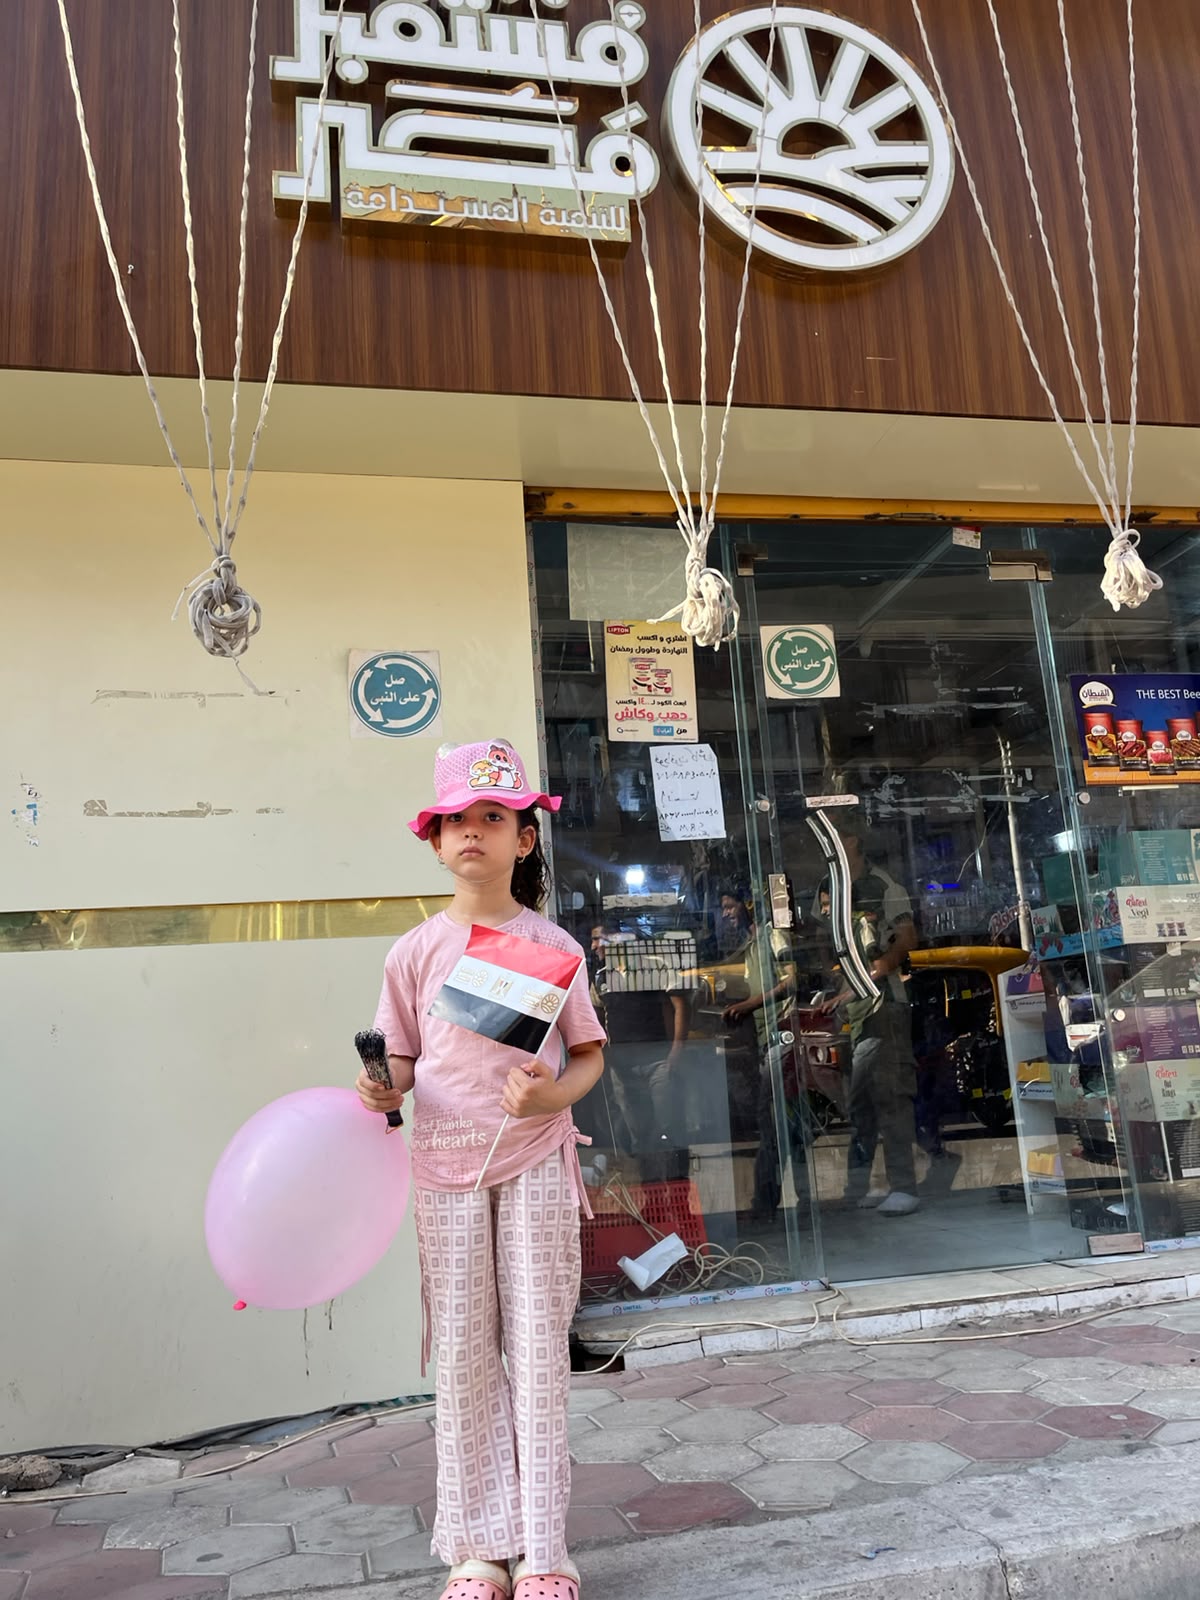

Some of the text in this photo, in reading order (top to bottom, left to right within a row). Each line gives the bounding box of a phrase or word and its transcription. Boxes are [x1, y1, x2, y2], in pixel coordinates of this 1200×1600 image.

[346, 182, 627, 233] للتنمية المستدامة
[636, 634, 658, 642] اكسب
[666, 634, 687, 644] اشتري
[610, 644, 634, 654] رمضان
[790, 644, 809, 657] صل
[803, 658, 821, 671] على
[384, 673, 406, 688] صل
[398, 691, 421, 705] على
[1136, 689, 1156, 700] THE
[1158, 689, 1181, 699] BEST
[614, 706, 688, 722] دهب وكاش
[432, 1128, 487, 1150] hearts
